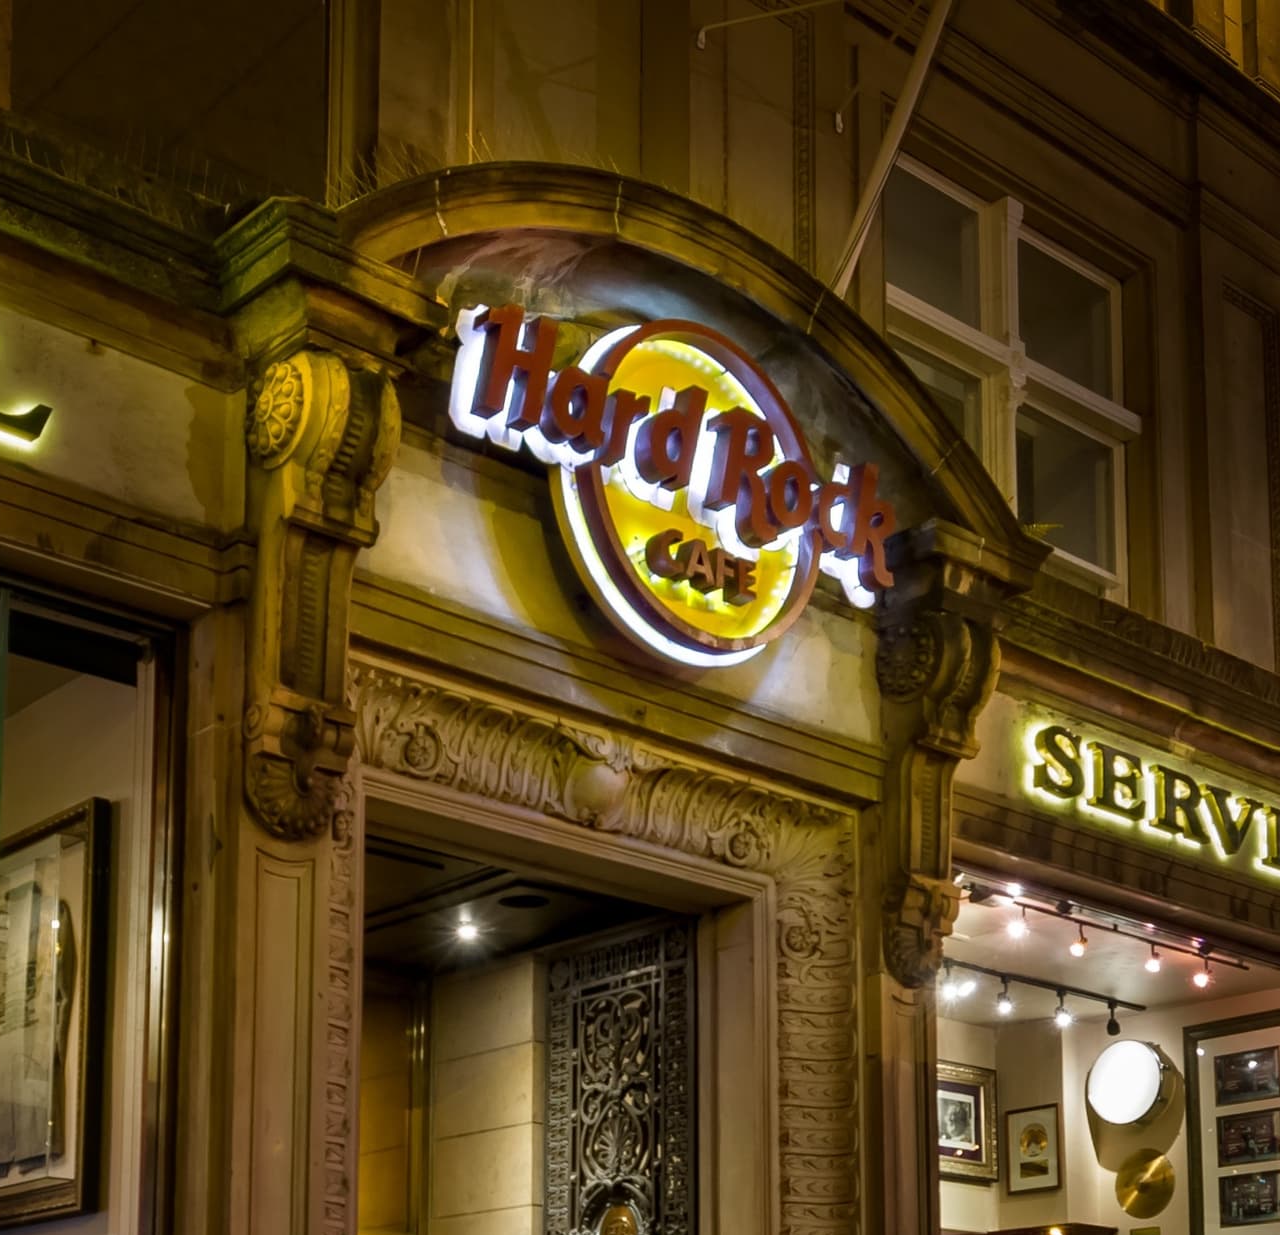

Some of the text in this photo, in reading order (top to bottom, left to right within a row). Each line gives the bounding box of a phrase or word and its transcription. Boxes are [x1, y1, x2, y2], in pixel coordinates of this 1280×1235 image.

[455, 304, 896, 596] Hard Rock
[645, 528, 758, 606] CAFE
